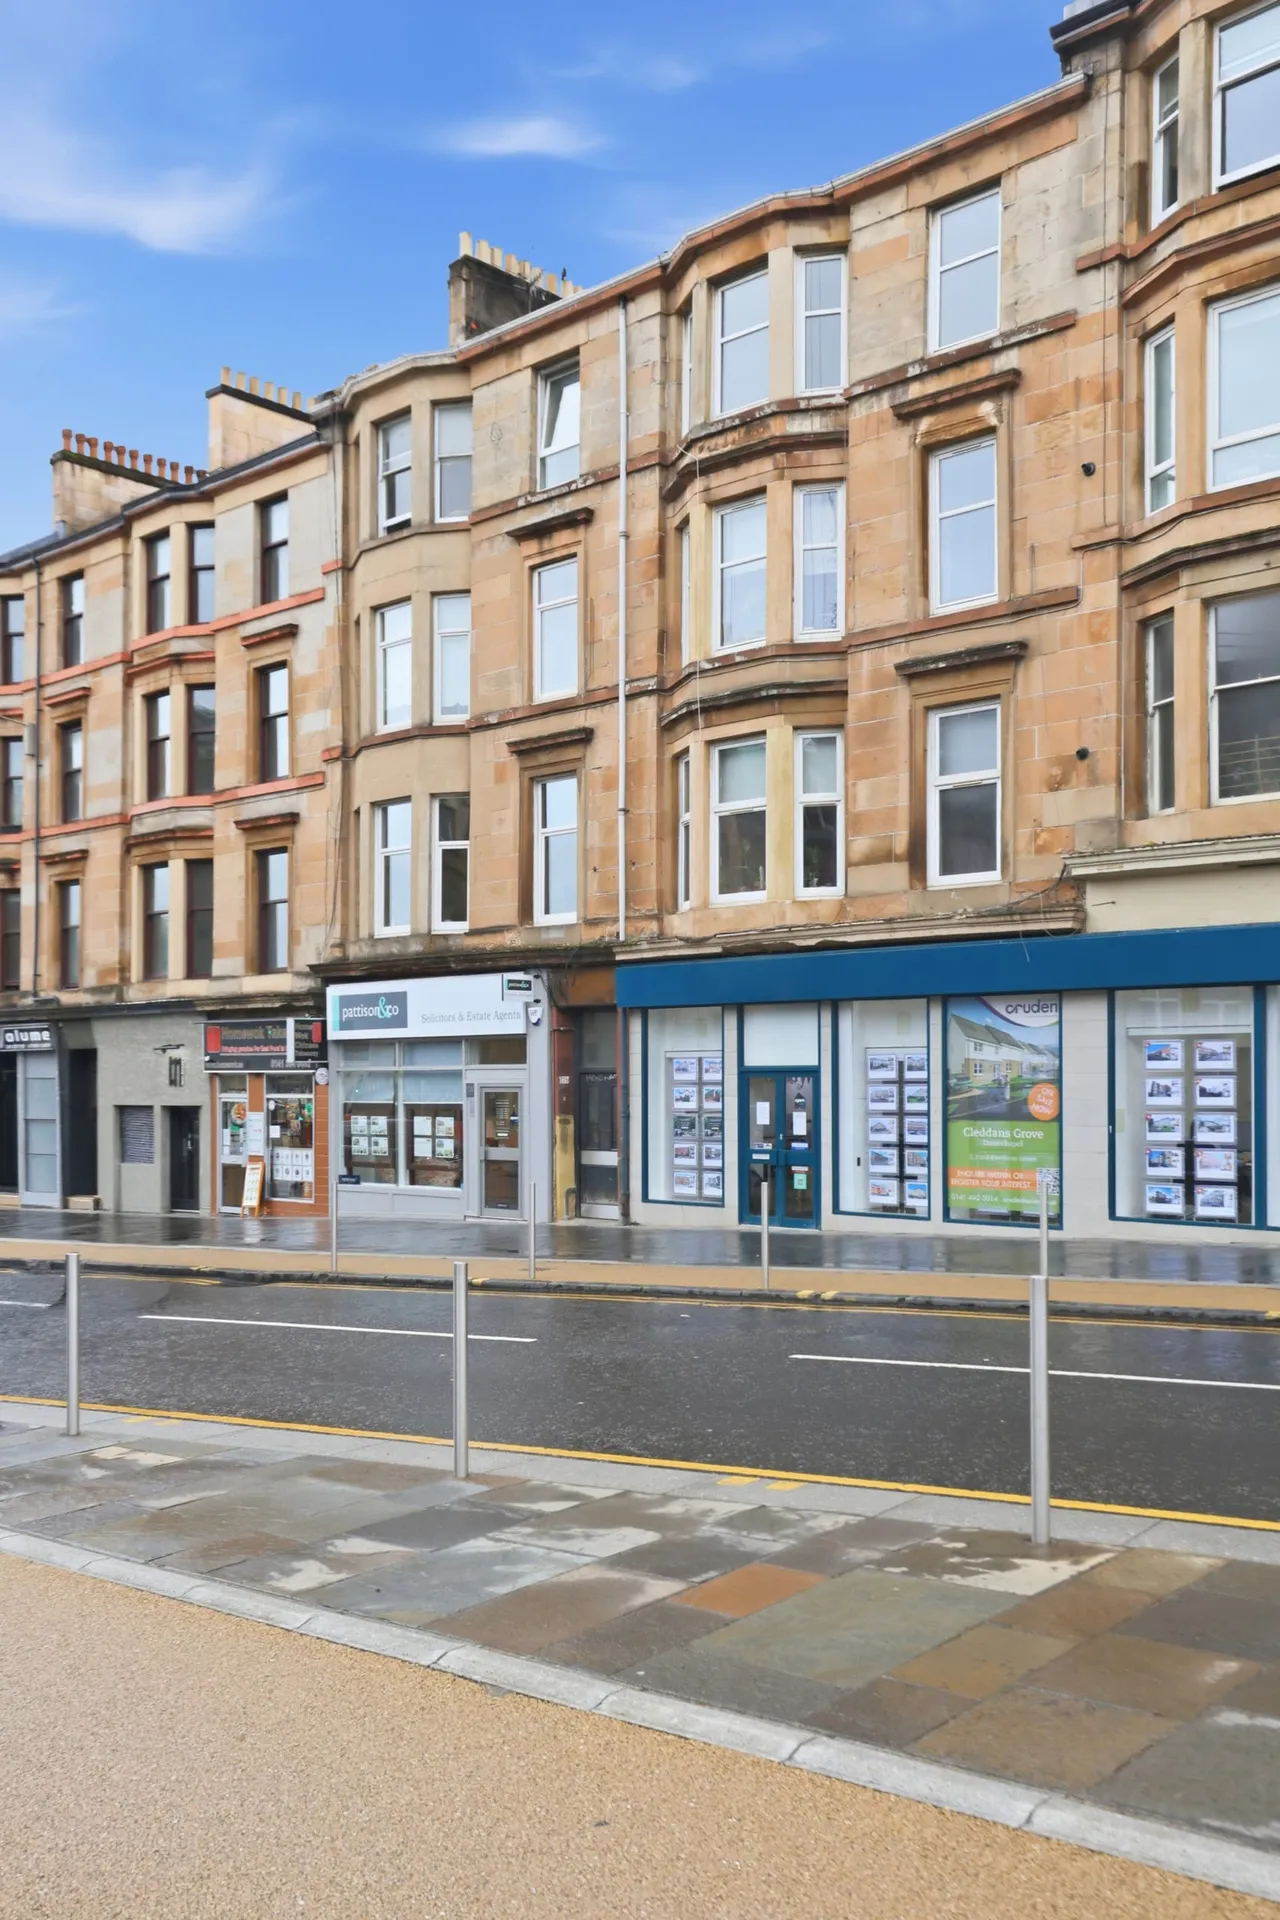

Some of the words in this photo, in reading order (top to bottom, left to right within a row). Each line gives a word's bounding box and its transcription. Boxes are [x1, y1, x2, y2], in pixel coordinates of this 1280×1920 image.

[342, 996, 399, 1022] pattison&co
[1005, 999, 1058, 1014] cruden
[421, 1013, 456, 1023] Solicitors
[458, 1012, 464, 1021] &
[466, 1011, 491, 1021] Estate
[493, 1010, 521, 1022] Agents
[963, 1127, 1010, 1138] Cleddans
[1013, 1128, 1044, 1139] Grove
